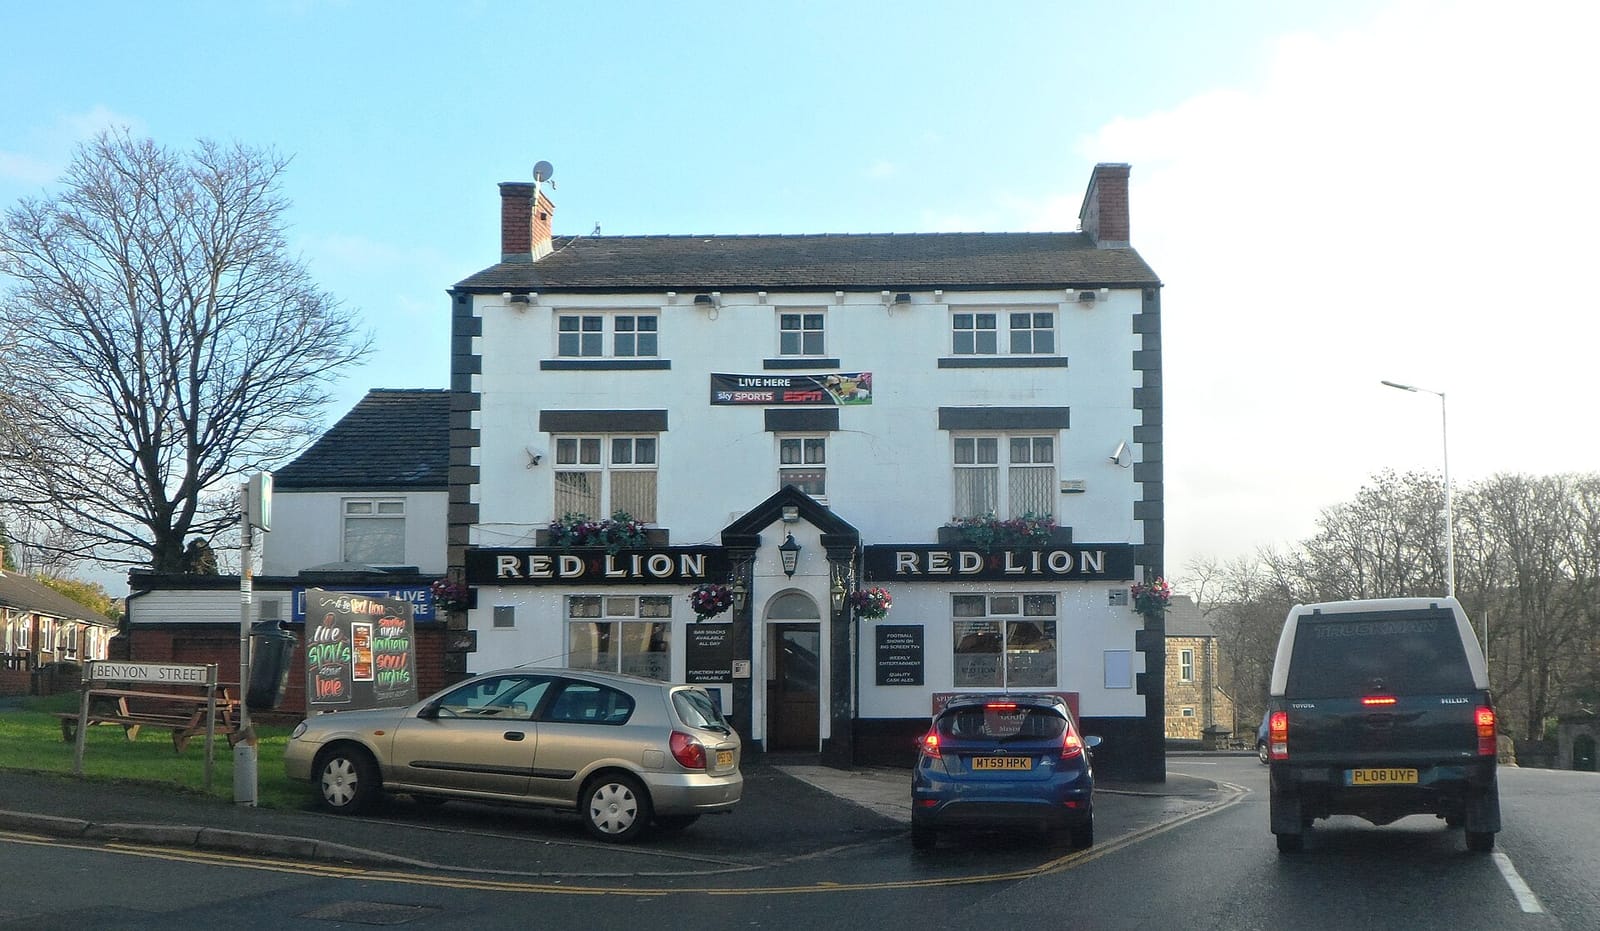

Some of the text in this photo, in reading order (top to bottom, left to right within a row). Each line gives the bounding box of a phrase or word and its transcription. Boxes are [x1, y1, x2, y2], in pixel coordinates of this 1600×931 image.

[738, 378, 791, 387] LIVE HERE
[717, 391, 822, 402] sky SPORTS ESPN
[496, 553, 708, 579] RED LION
[895, 550, 1106, 575] RED LION
[395, 590, 425, 602] LIVE
[1315, 620, 1439, 637] TRUCKMAN
[308, 641, 351, 669] sports
[97, 665, 205, 681] BENYON STREET
[315, 674, 344, 699] here
[976, 758, 1027, 768] MT59 HPK
[1354, 769, 1416, 782] PL08 UYF
